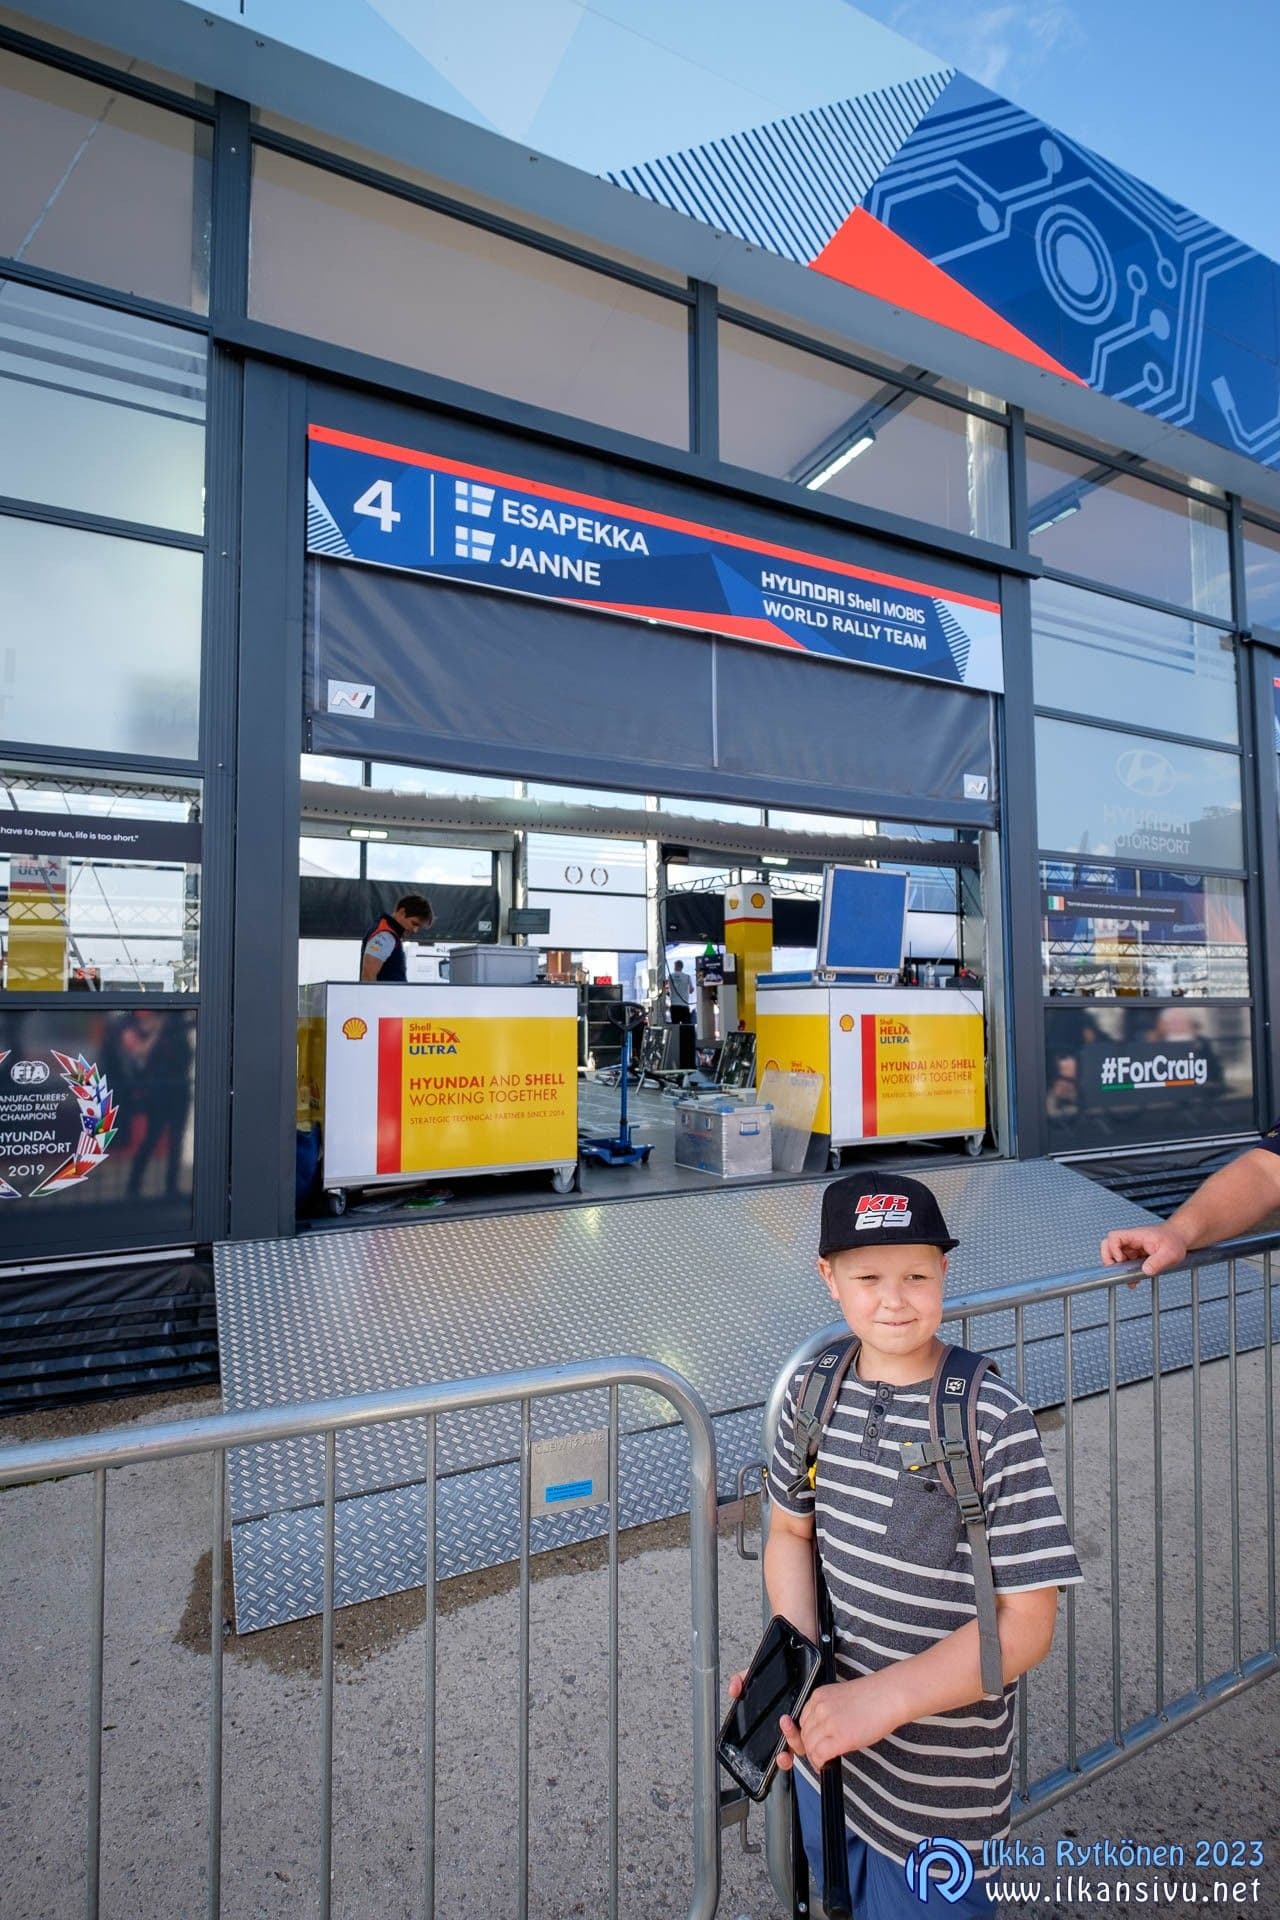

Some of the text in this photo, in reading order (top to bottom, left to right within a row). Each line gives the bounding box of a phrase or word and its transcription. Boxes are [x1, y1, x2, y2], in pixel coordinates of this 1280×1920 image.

[353, 479, 401, 533] 4
[502, 498, 650, 556] ESAPEKKA
[500, 544, 601, 586] JANNE
[761, 571, 926, 624] HYUNDAI Shell MOBIS
[763, 600, 927, 650] WORLD RALLY TEAM
[24, 828, 33, 836] to
[35, 828, 57, 837] have
[58, 830, 74, 839] fun,
[75, 831, 88, 839] life
[89, 832, 96, 840] is
[98, 833, 112, 841] too
[409, 1023, 431, 1031] Shell
[880, 1024, 911, 1035] HELIX
[409, 1030, 460, 1044] HELIX
[880, 1036, 910, 1044] ULTRA
[409, 1045, 458, 1055] ULTRA
[881, 1059, 977, 1072] HYUNDAI AND SHELL
[1101, 1052, 1208, 1085] #ForCraig
[410, 1073, 565, 1090] HYUNDAI AND SHELL
[881, 1071, 973, 1085] WORKING TOGETHER
[410, 1089, 558, 1107] WORKING TOGETHER
[0, 1102, 59, 1112] WORLD RALLY
[1, 1112, 57, 1121] CHAMPIONS
[410, 1115, 450, 1125] STRATEGIC
[452, 1113, 493, 1122] TECHNICAL
[8, 1164, 45, 1177] 2019
[855, 1210, 912, 1231] 69
